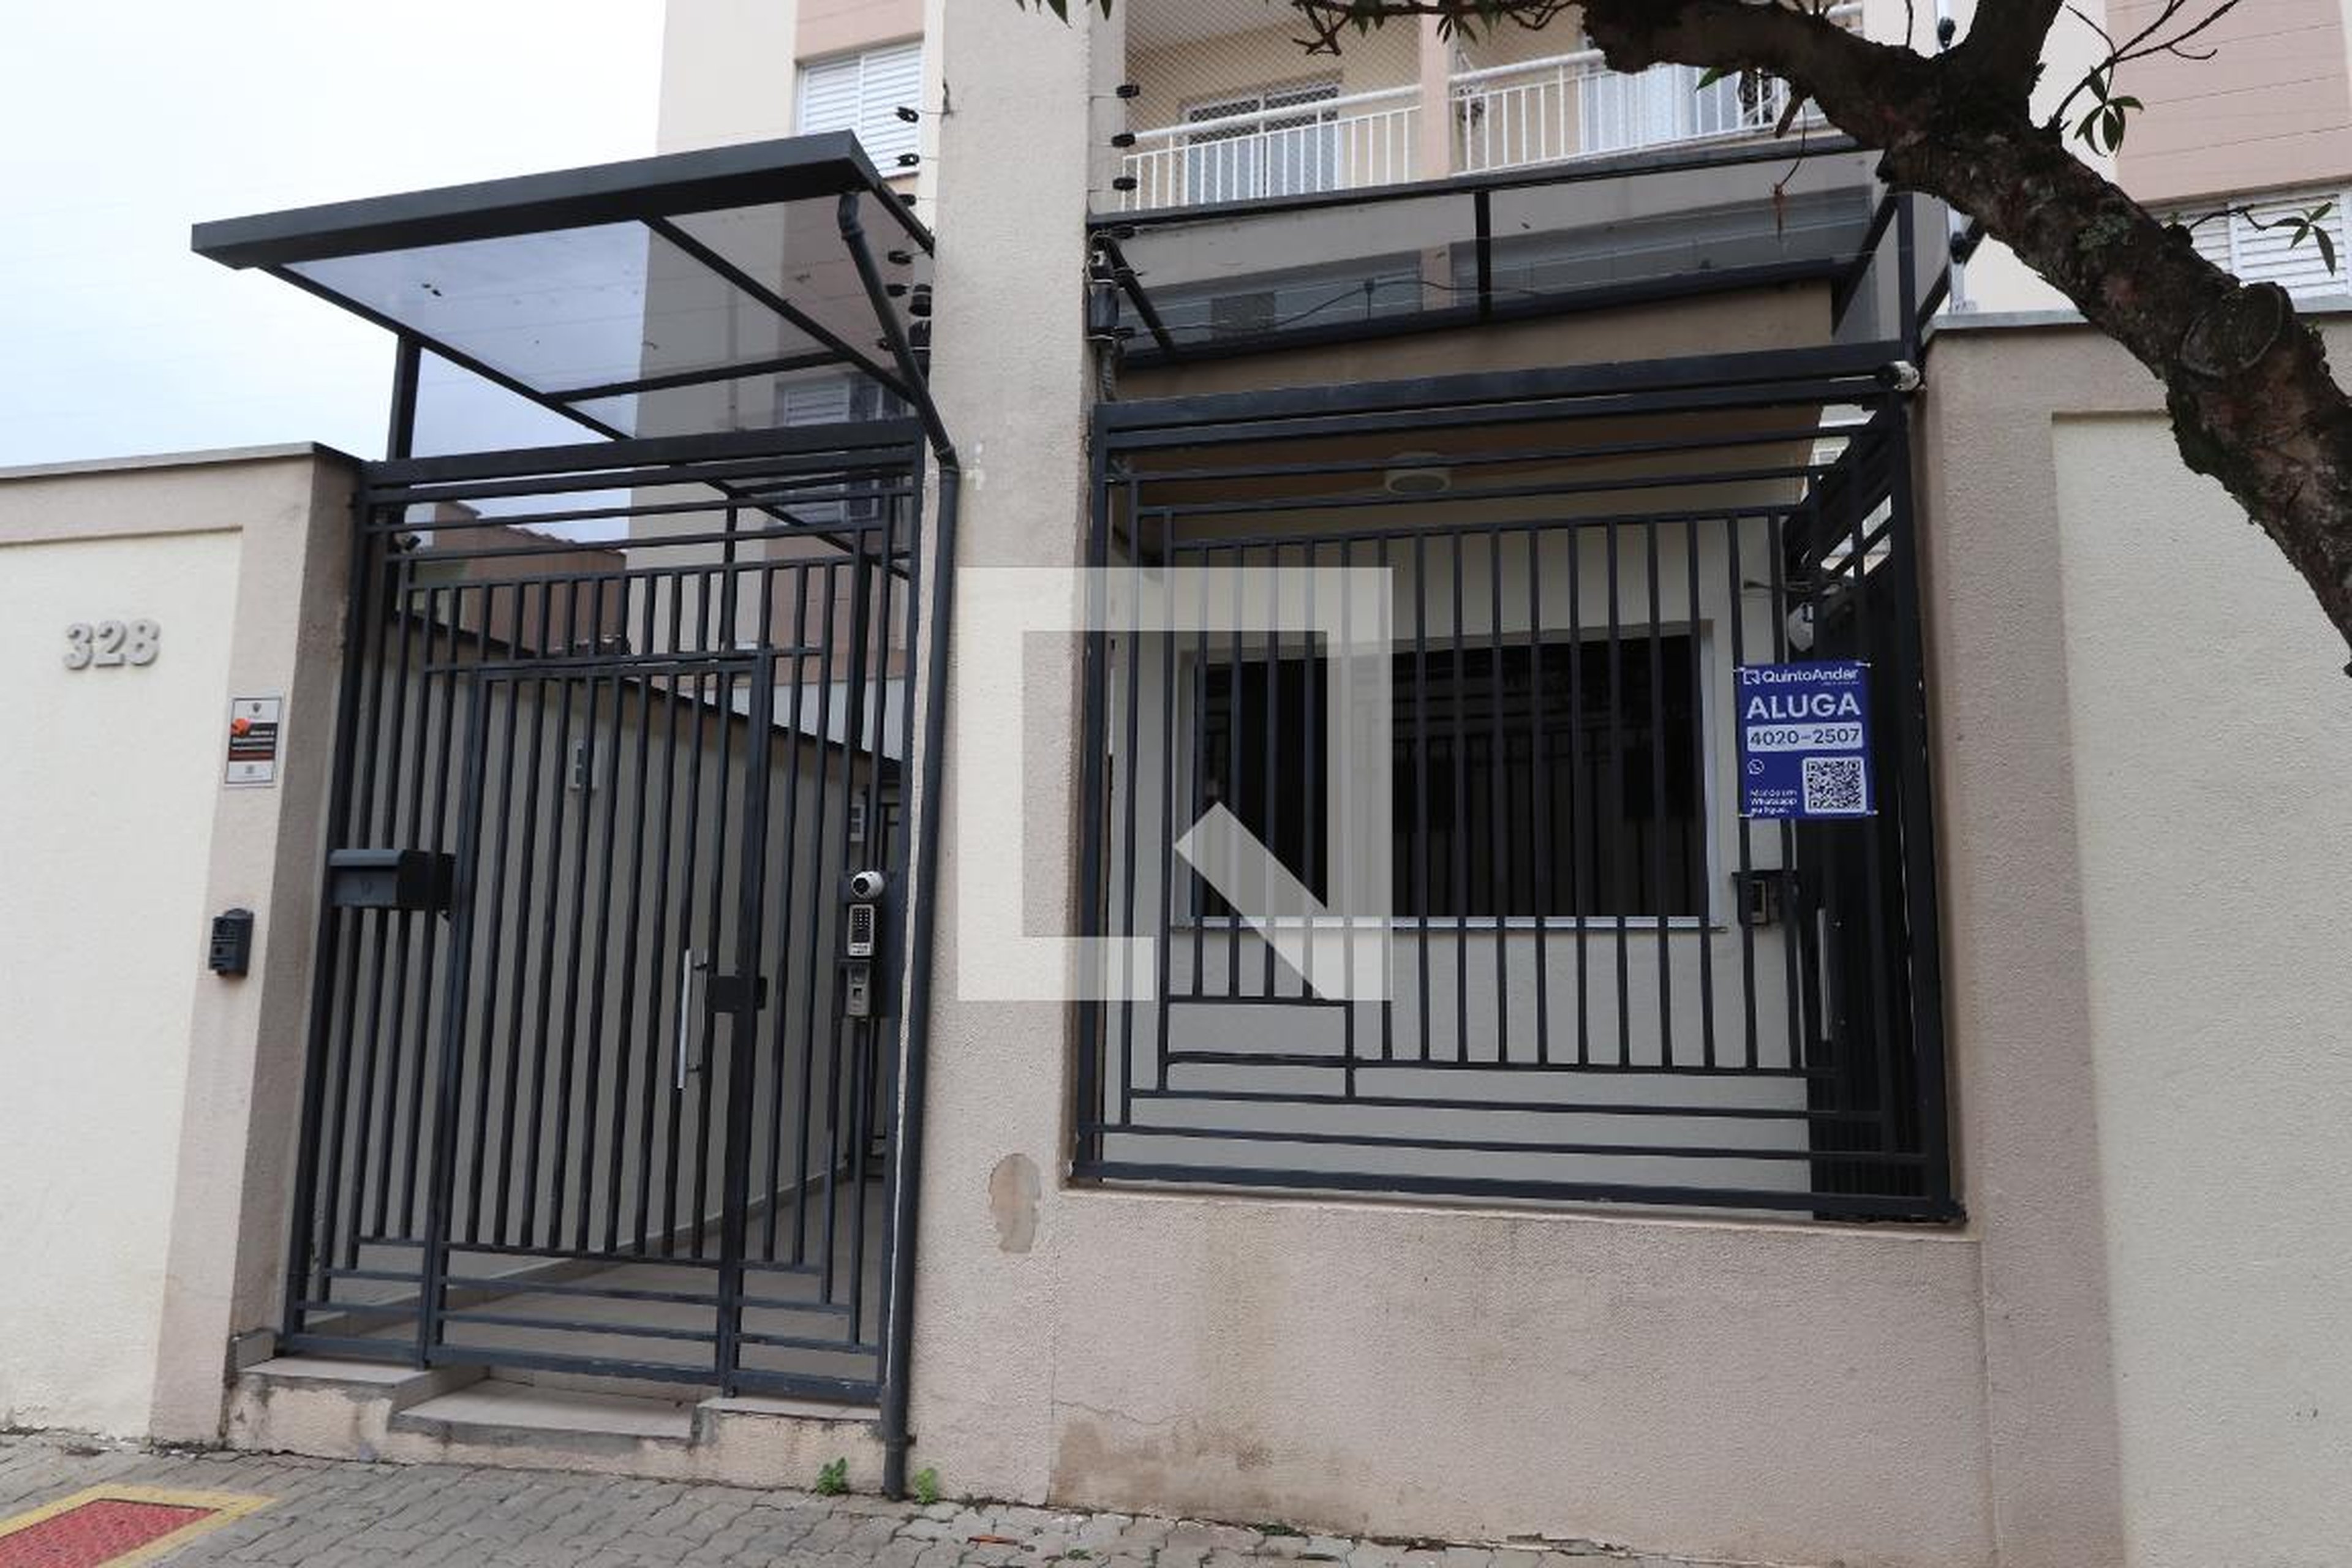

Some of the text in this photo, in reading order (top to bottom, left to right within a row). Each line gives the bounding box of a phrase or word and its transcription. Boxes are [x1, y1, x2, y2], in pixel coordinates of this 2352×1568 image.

[63, 618, 160, 671] 328
[1746, 692, 1861, 719] ALUGA
[1750, 728, 1860, 746] 4020-2507
